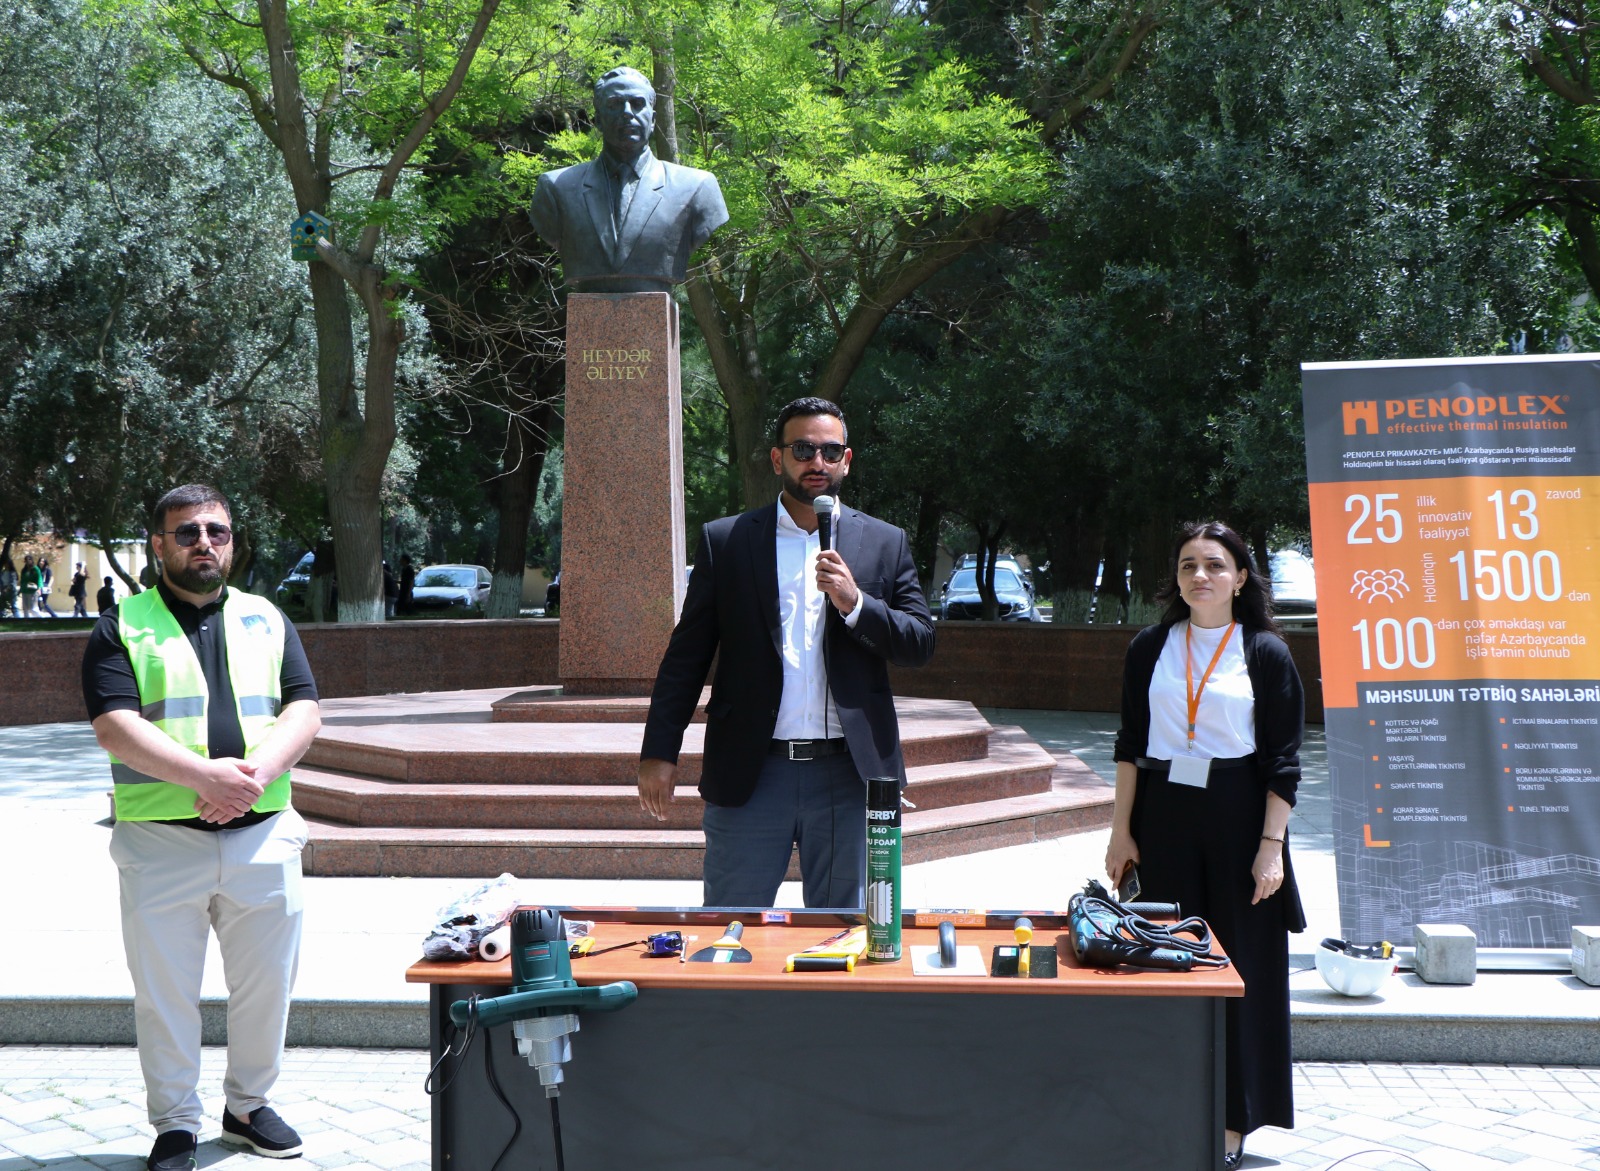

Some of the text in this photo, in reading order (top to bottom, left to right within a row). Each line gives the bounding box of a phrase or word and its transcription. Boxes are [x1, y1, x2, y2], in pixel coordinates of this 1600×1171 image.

[582, 349, 652, 363] HEYDƏR
[586, 364, 648, 380] ƏLİYEV
[1387, 418, 1568, 434] effective thermal insulation
[1443, 446, 1463, 456] MMC
[1515, 446, 1539, 455] Rusiya
[1385, 459, 1395, 467] bir
[1396, 457, 1422, 467] hissəsi
[1423, 457, 1446, 466] olaraq
[1511, 456, 1527, 465] yeni
[1416, 495, 1437, 507] illik
[1546, 488, 1582, 500] zavod
[1344, 493, 1403, 545] 25
[1418, 509, 1473, 523] innovativ
[1487, 488, 1540, 540] 13
[1419, 526, 1471, 541] fəaliyyət
[1421, 552, 1438, 603] Holdinqin
[1449, 549, 1563, 601] 1500
[1564, 590, 1591, 602] -dən
[1434, 617, 1567, 633] -dən çox əməkdaşı var
[1352, 616, 1436, 670] 100
[1465, 632, 1587, 648] nəfər Azərbaycanda
[1466, 646, 1571, 660] işlə təmin olunub
[1365, 685, 1600, 704] MƏHSULUN TƏTBİQ SAHƏLƏRİ
[873, 838, 897, 846] FOAM
